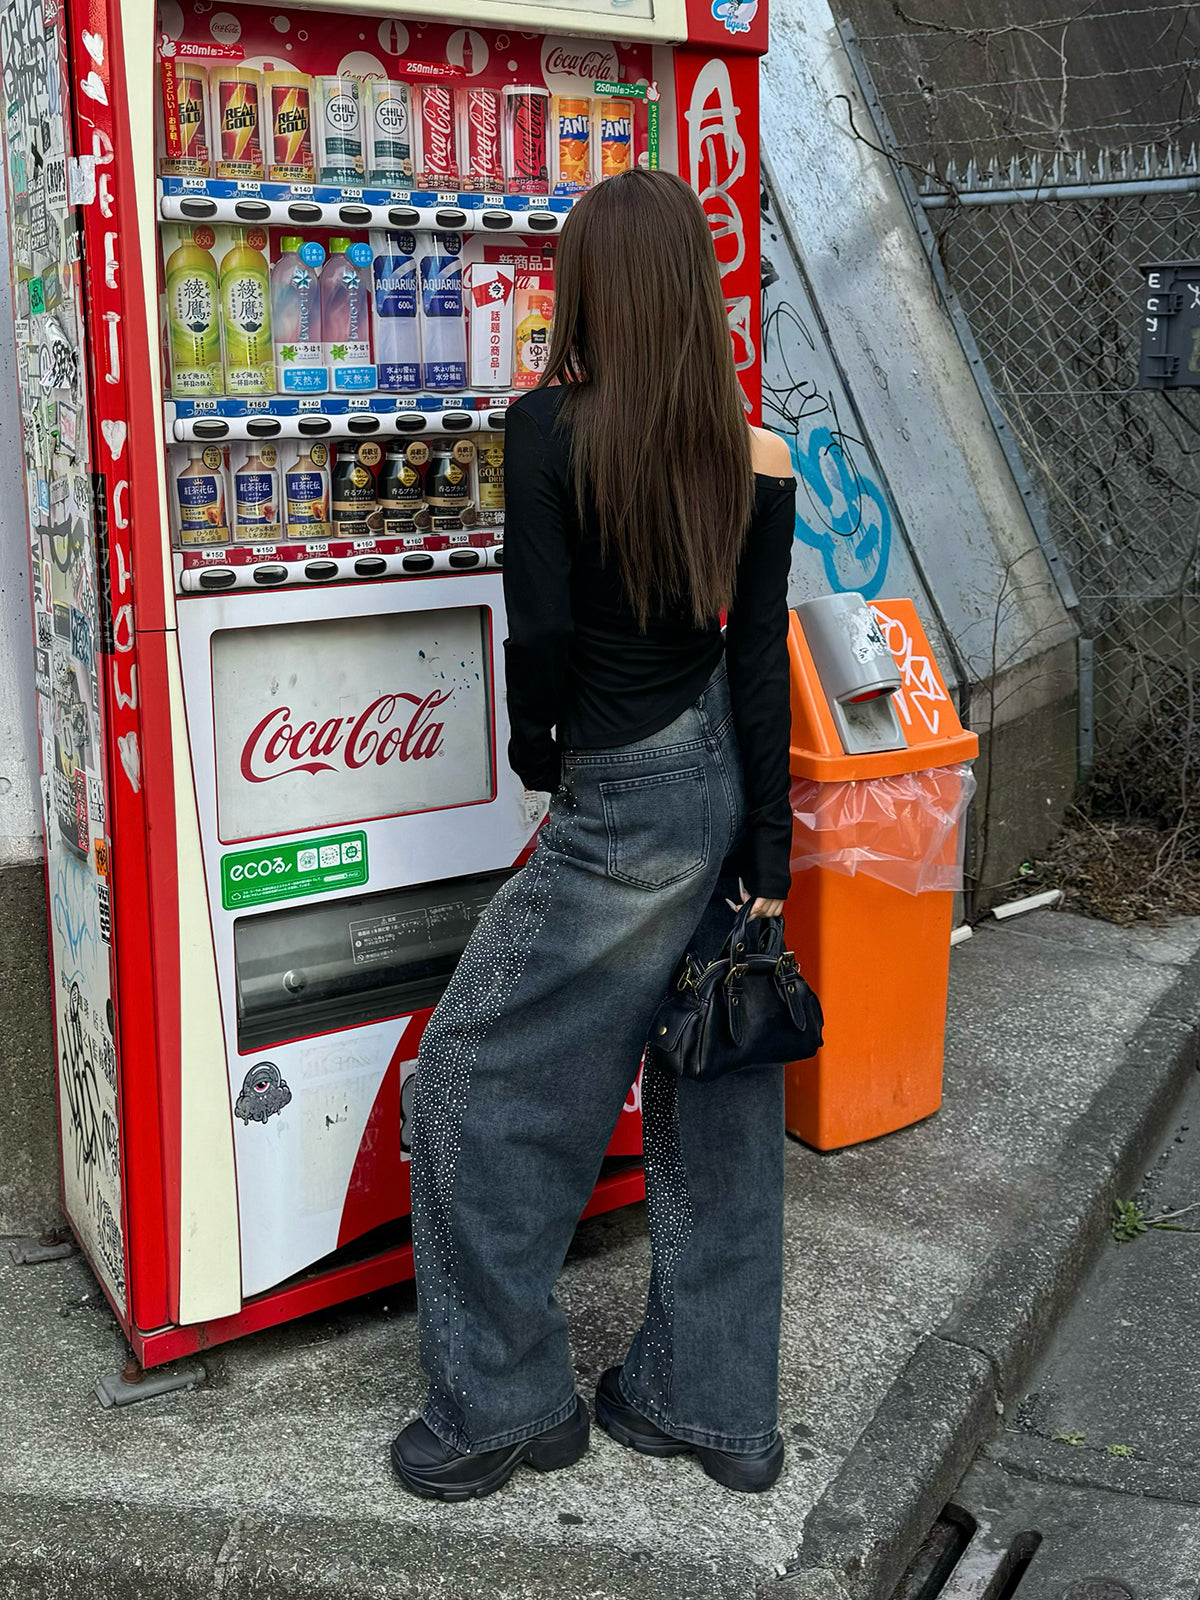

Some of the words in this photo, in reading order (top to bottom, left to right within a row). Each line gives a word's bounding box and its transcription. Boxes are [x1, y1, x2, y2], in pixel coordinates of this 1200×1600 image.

[545, 46, 615, 81] Coca-Cola
[226, 103, 256, 120] REAL
[278, 107, 306, 124] REAL
[330, 104, 356, 115] CHILL
[379, 107, 404, 118] CHILL
[226, 116, 256, 131] GOLD
[333, 114, 355, 123] OUT
[382, 117, 403, 127] OUT
[560, 115, 588, 134] FANT
[278, 119, 307, 135] GOLD
[423, 88, 451, 174] Coca-Cola
[469, 91, 497, 177] Coca-Cola
[602, 118, 630, 137] FANT
[515, 95, 542, 178] Coca-Cola
[376, 279, 416, 291] AQUARIUS
[423, 279, 461, 291] AQUARIUS
[492, 284, 502, 296] 今
[184, 279, 207, 321] 綾鷹
[237, 279, 260, 321] 綾鷹
[529, 344, 543, 370] ゆず
[293, 376, 322, 387] 天然水
[343, 374, 371, 385] 天然水
[184, 485, 215, 496] 紅茶花伝
[239, 482, 270, 492] 紅茶花伝
[291, 481, 321, 490] 紅茶花伝
[240, 689, 455, 783] Coca-Cola
